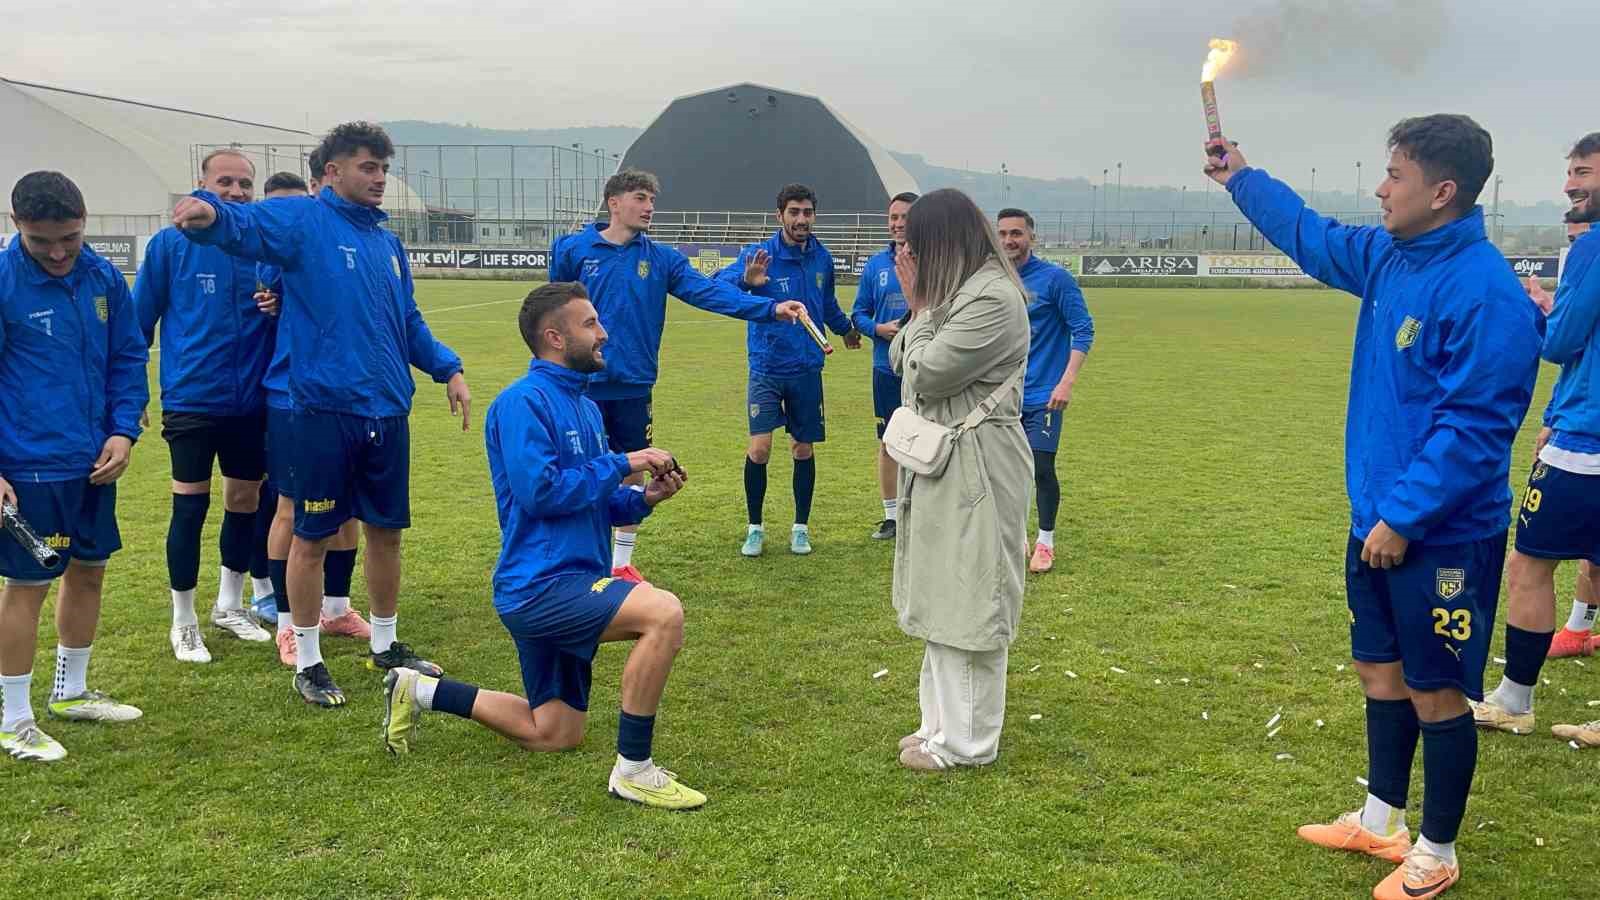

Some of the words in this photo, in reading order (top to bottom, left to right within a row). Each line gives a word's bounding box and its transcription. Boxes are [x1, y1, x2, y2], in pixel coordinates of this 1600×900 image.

[346, 253, 354, 269] 5
[483, 254, 509, 266] LIFE
[511, 254, 546, 267] SPOR
[1514, 259, 1544, 276] asya
[200, 279, 216, 294] 18
[880, 271, 889, 287] 8
[40, 318, 52, 336] 7
[1045, 413, 1051, 427] 1
[1523, 486, 1543, 512] 19
[1432, 608, 1472, 641] 23
